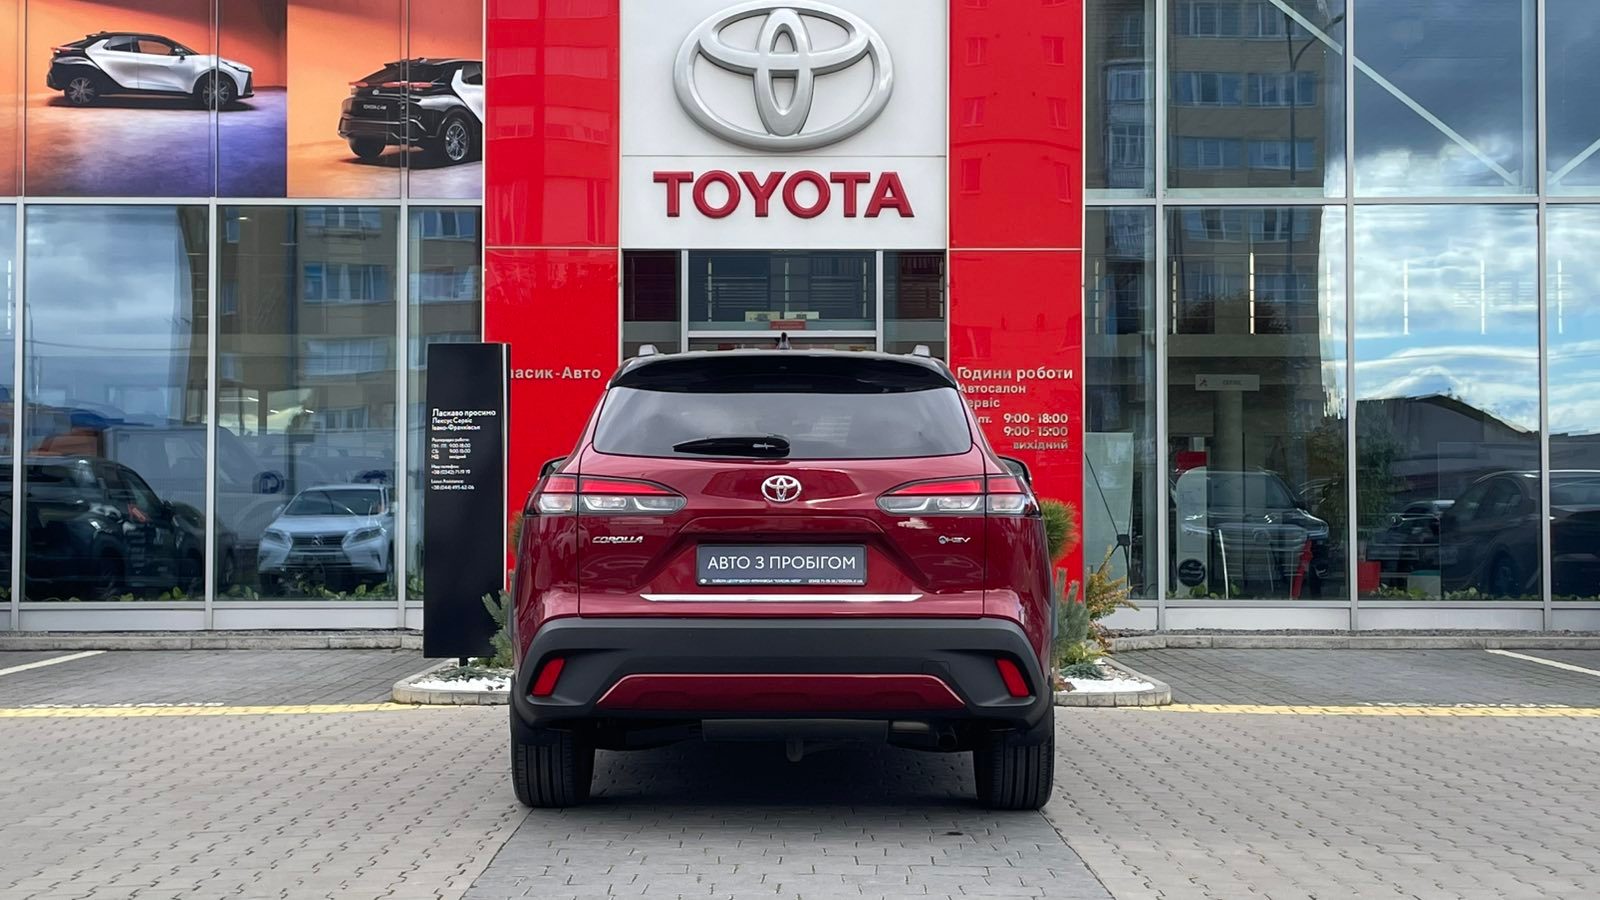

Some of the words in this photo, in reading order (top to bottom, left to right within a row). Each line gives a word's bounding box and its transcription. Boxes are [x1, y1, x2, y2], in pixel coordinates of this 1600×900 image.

[653, 170, 915, 219] TOYOTA
[957, 366, 1012, 381] Години
[1016, 366, 1073, 382] роботи
[959, 383, 1026, 394] Автосалон
[967, 397, 1001, 410] ервіс
[432, 408, 464, 417] Ласкаво
[1013, 440, 1068, 451] вихідний
[592, 536, 644, 544] COROLLA
[707, 556, 750, 569] АВТО
[769, 556, 856, 569] ПРОБІГОМ
